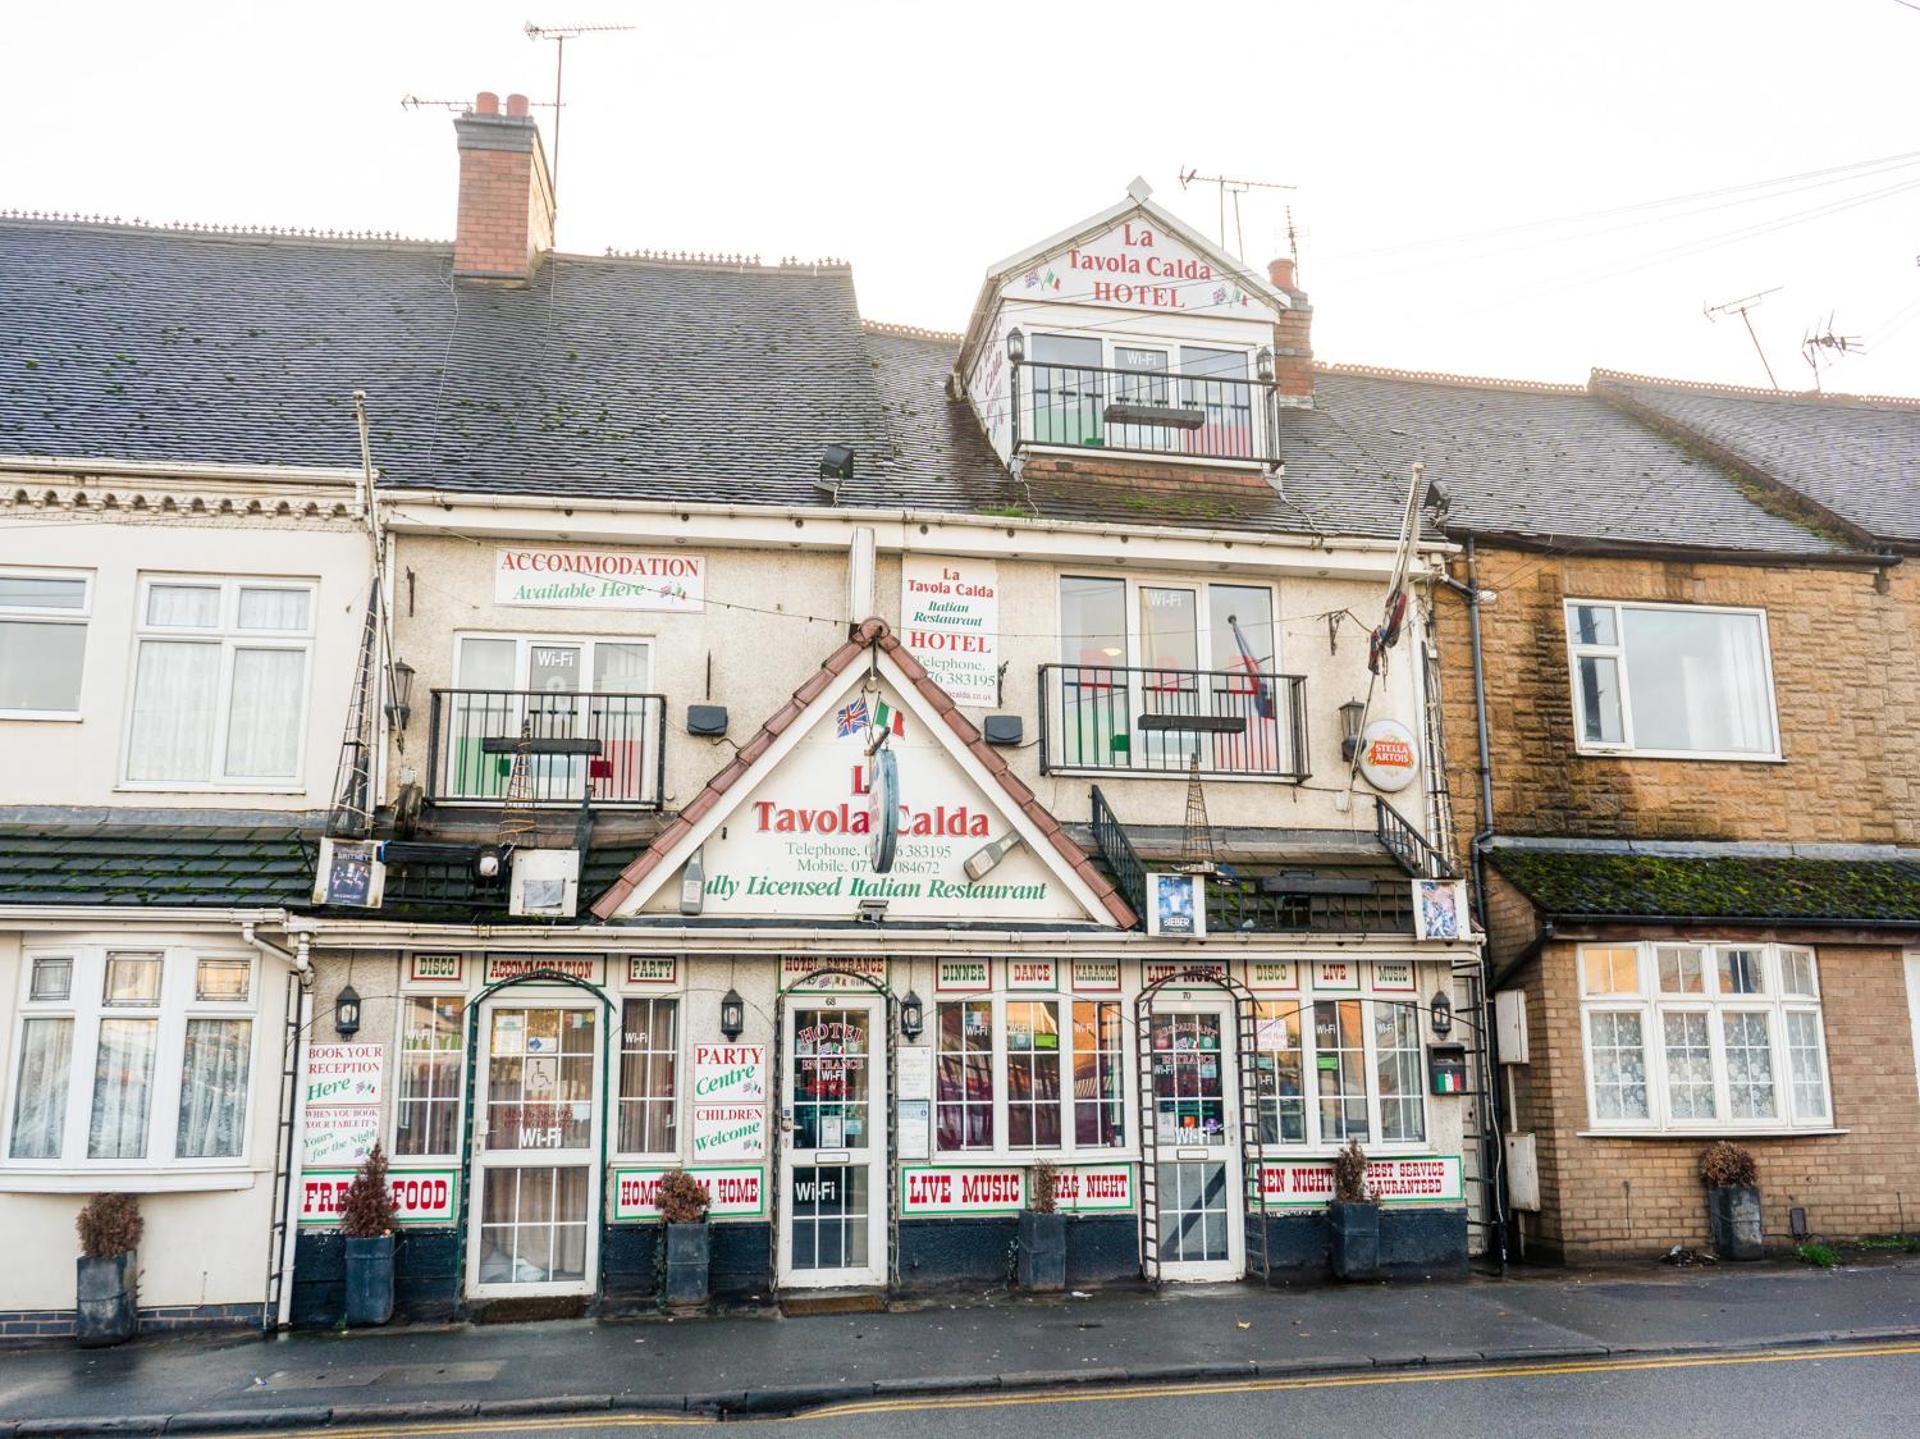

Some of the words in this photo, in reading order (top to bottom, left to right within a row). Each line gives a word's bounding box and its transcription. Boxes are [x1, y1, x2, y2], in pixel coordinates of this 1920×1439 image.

[1124, 224, 1153, 247] La
[1067, 249, 1140, 274] Tavola
[1147, 257, 1211, 281] Calda
[1094, 282, 1185, 308] HOTEL
[1127, 352, 1157, 366] Wi-Fi
[501, 552, 699, 577] ACCOMMODATION
[944, 568, 960, 581] La
[514, 584, 595, 600] Available
[601, 582, 644, 597] Here
[908, 580, 950, 594] Tavola
[956, 584, 994, 598] Calda
[928, 601, 969, 613] Italian
[1151, 592, 1182, 607] Wi-Fi
[914, 612, 982, 627] Restaurant
[910, 631, 991, 653] HOTEL
[537, 651, 574, 667] Wi-Fi
[946, 673, 995, 687] 383195
[1375, 744, 1408, 754] STELLA
[1375, 752, 1409, 763] ARTOIS
[852, 765, 870, 795] L
[753, 801, 869, 834] Tavola
[896, 804, 990, 837] Calda
[906, 845, 951, 859] 383195
[705, 874, 740, 901] ully
[746, 876, 843, 897] Licensed
[849, 877, 921, 897] Italian
[928, 879, 1047, 900] Restaurant
[419, 958, 455, 976] DISCO
[632, 960, 673, 978] PARTY
[785, 956, 819, 972] HOTEL
[826, 957, 884, 972] ENTRANCE
[942, 964, 986, 982] DINNER
[1013, 964, 1050, 982] DANCE
[1075, 964, 1117, 982] KARAOKE
[1256, 964, 1287, 981] DISCO
[1322, 964, 1346, 981] LIVE
[1378, 965, 1408, 982] MUSIC
[1182, 992, 1192, 1000] 70
[625, 1032, 649, 1044] Wi-Fi
[799, 1022, 863, 1044] HOTEL
[309, 1048, 343, 1059] BOOK
[347, 1047, 383, 1058] YOUR
[696, 1047, 763, 1065] PARTY
[308, 1062, 380, 1074] RECEPTION
[822, 1070, 845, 1081] Wi-Fi
[307, 1078, 351, 1101] Here
[696, 1065, 755, 1096] Centre
[305, 1110, 331, 1118] WHEN
[333, 1110, 349, 1118] YOU
[353, 1109, 378, 1117] BOOK
[696, 1109, 764, 1121] CHILDREN
[306, 1120, 330, 1128] YOUR
[333, 1120, 358, 1128] TABLE
[304, 1132, 334, 1148] Yours
[520, 1127, 562, 1147] Wi-Fi
[695, 1121, 760, 1152] Welcome
[332, 1140, 347, 1153] the
[1366, 1162, 1394, 1178] BEST
[1400, 1161, 1445, 1177] SERVICE
[909, 1175, 952, 1204] LIVE
[962, 1174, 1020, 1203] MUSIC
[1053, 1175, 1081, 1199] TAG
[1086, 1174, 1127, 1199] NIGHT
[1292, 1168, 1334, 1193] NIGHT
[1368, 1179, 1443, 1195] GAURANTEED
[304, 1182, 349, 1213] FRE
[389, 1180, 448, 1210] FOOD
[718, 1178, 758, 1204] HOME
[795, 1182, 835, 1201] Wi-Fi
